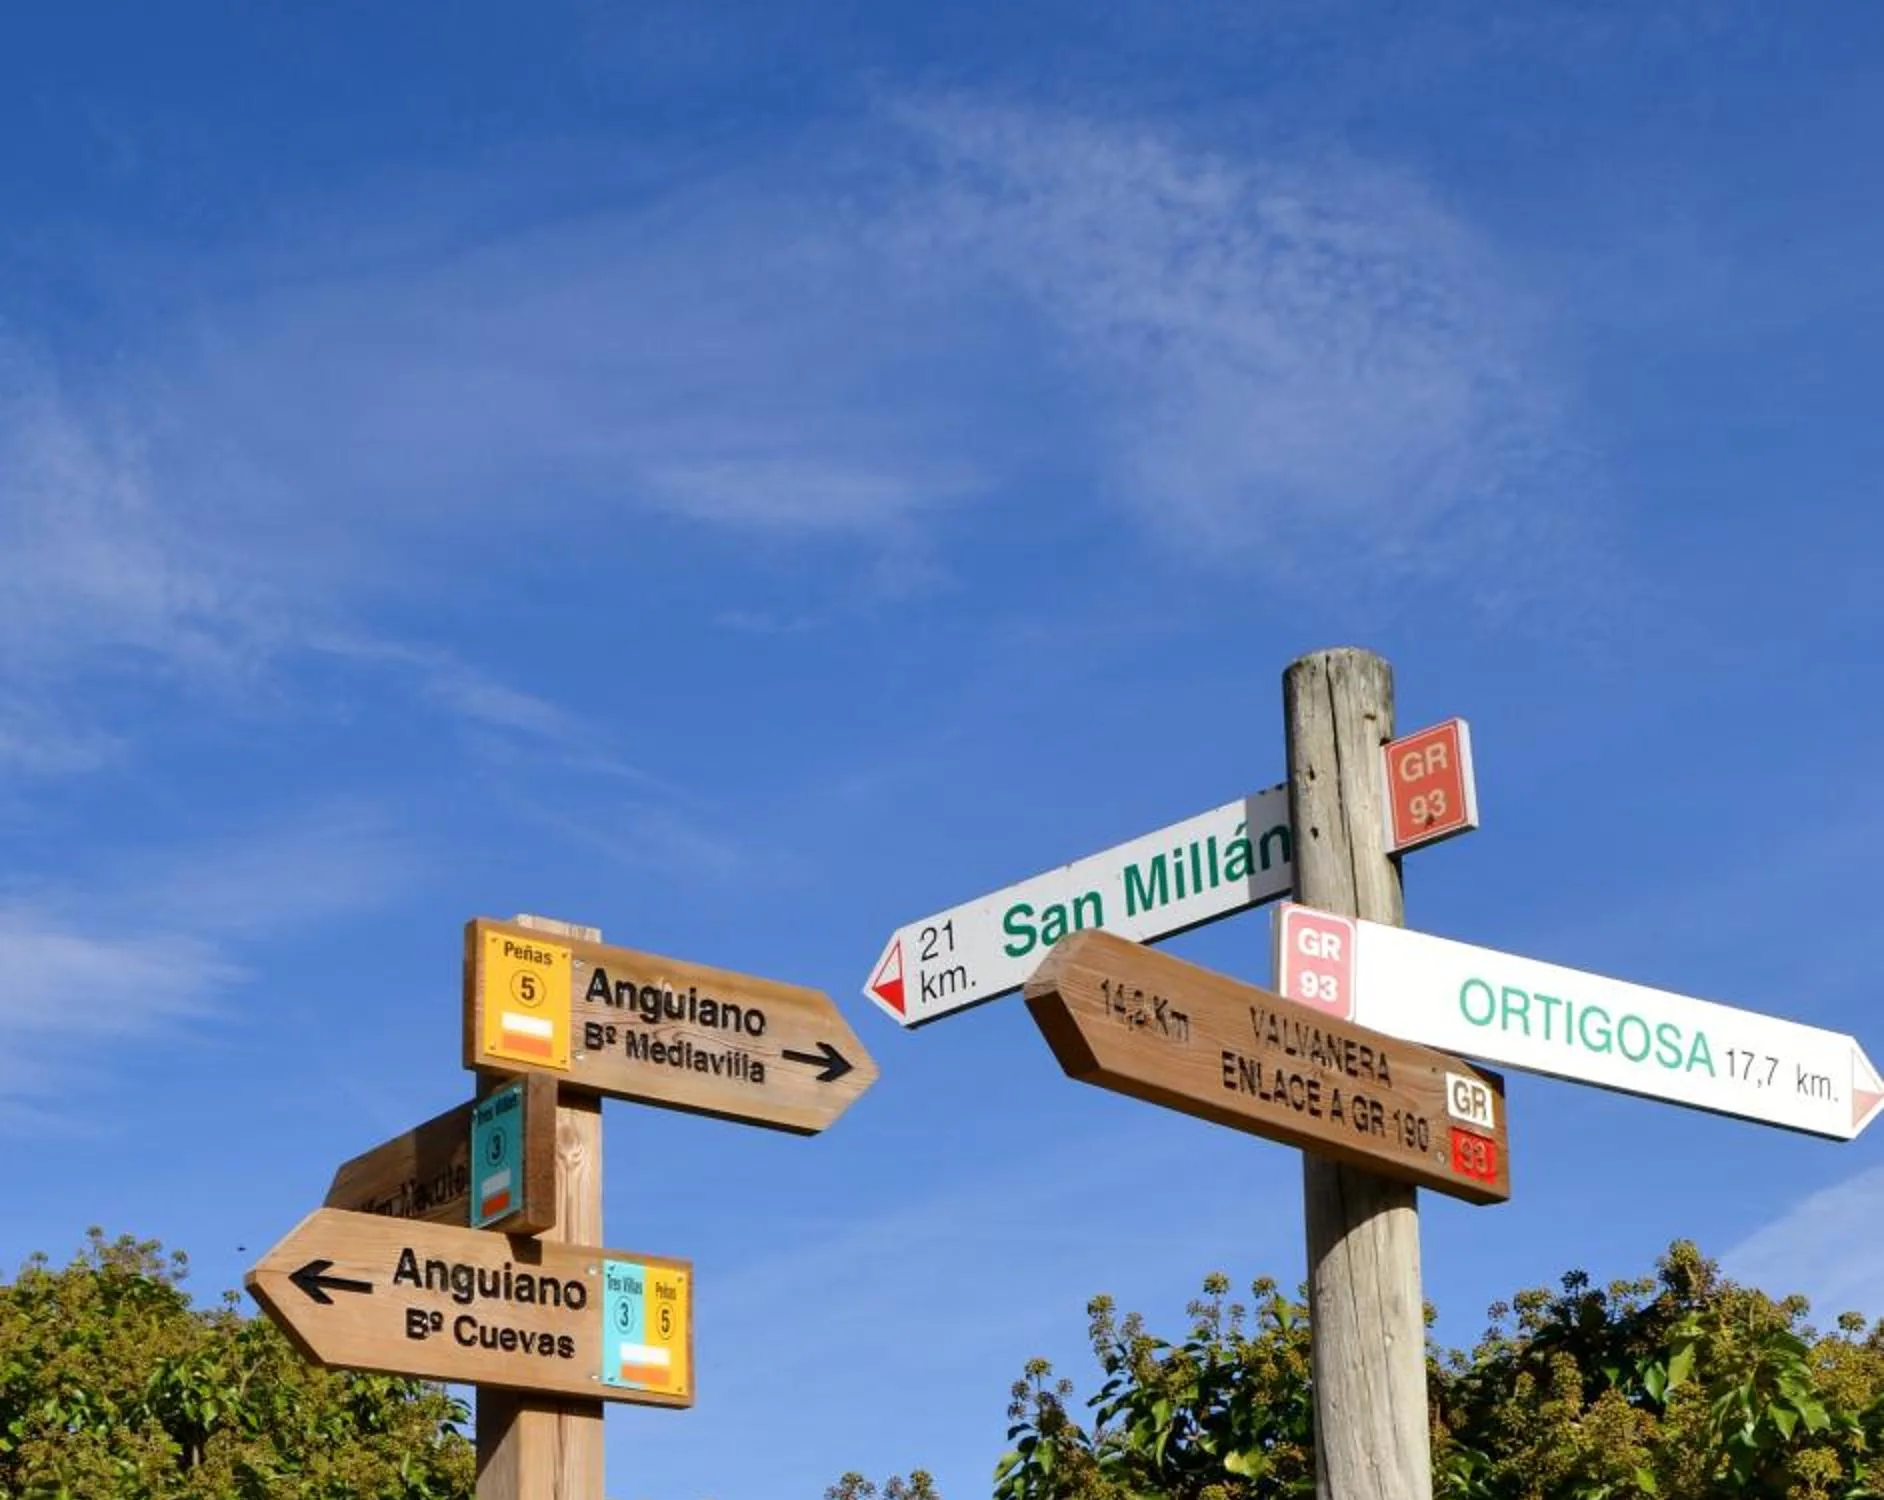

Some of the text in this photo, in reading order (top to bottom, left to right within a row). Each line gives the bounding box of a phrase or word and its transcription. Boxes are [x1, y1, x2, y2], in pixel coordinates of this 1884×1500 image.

[1400, 741, 1448, 782] GR
[1409, 788, 1447, 825] 93
[1002, 821, 1291, 958] San Millán
[503, 940, 553, 966] Peñas
[919, 919, 956, 962] 21
[1297, 928, 1341, 961] GR
[521, 975, 535, 1001] 5
[585, 967, 767, 1037] Anguiano
[920, 965, 977, 1003] km.
[1299, 974, 1338, 1001] 93
[1249, 1005, 1393, 1089] VALVANERA
[1459, 977, 1717, 1079] ORTIGOSA
[626, 1029, 766, 1084] Mediavilla
[1726, 1047, 1840, 1103] 17,7 km.
[1221, 1049, 1430, 1153] ENLACE A GR 190
[1453, 1079, 1487, 1120] GR
[491, 1134, 501, 1160] 3
[1461, 1136, 1487, 1174] 93
[393, 1247, 588, 1312] Anguiano
[620, 1301, 629, 1328] 3
[661, 1308, 671, 1334] 5
[453, 1314, 577, 1360] Cuevas
